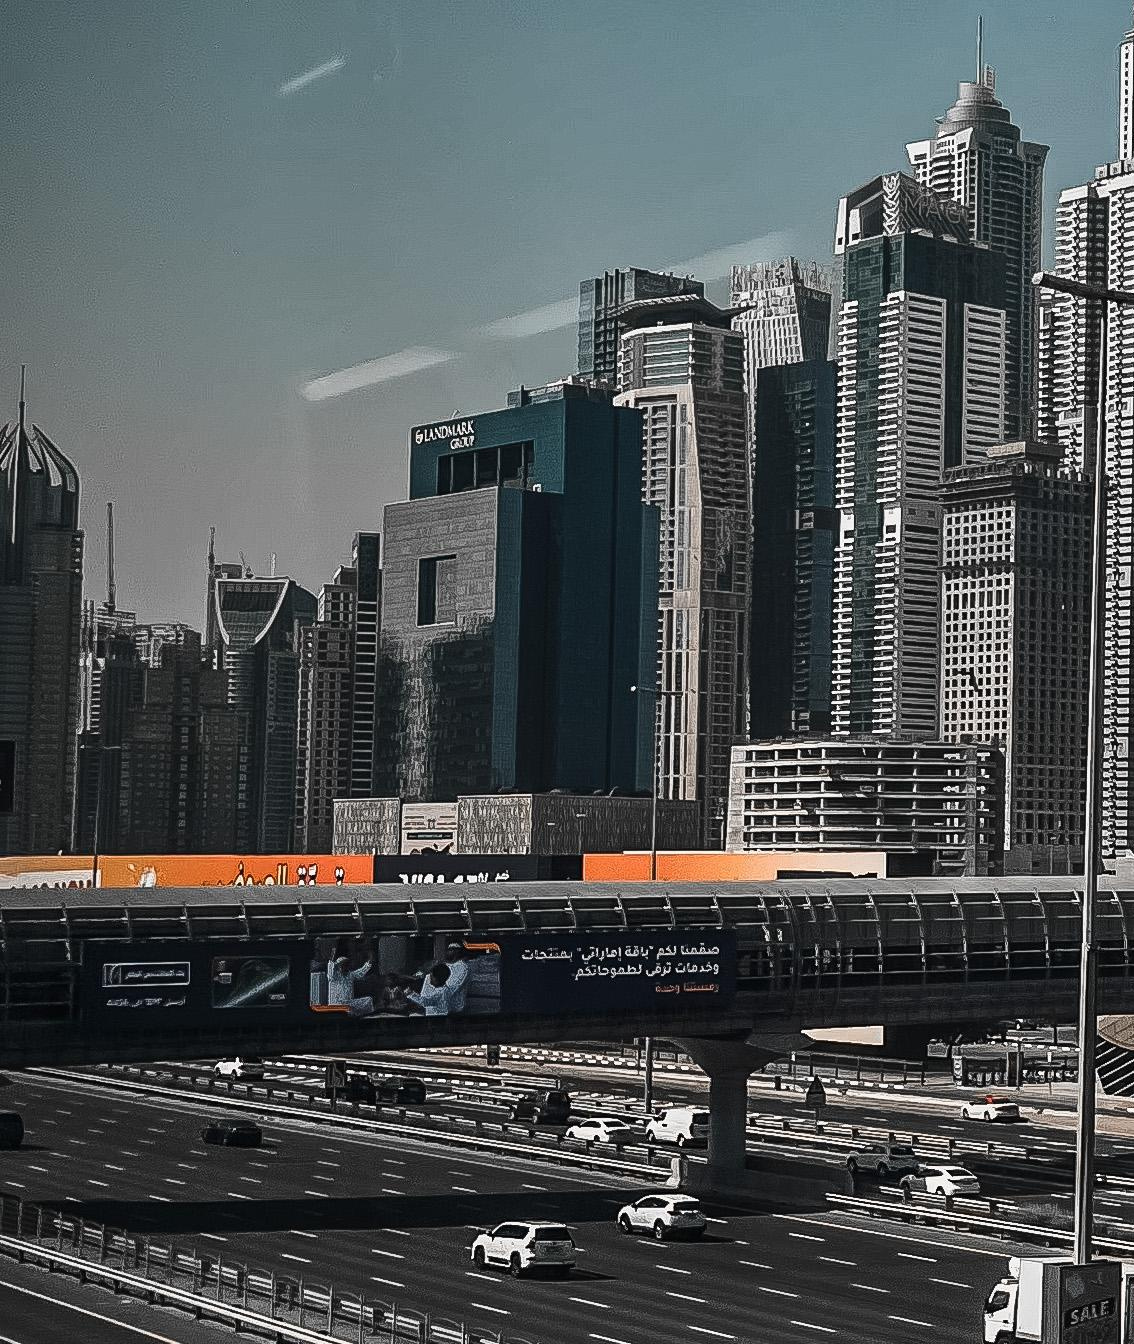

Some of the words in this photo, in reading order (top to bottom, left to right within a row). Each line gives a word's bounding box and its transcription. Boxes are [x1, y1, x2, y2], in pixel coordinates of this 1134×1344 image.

[424, 420, 475, 442] LANDMARK
[656, 945, 677, 958] لكم
[675, 961, 720, 975] وخدمات
[1070, 1300, 1110, 1326] SALE
